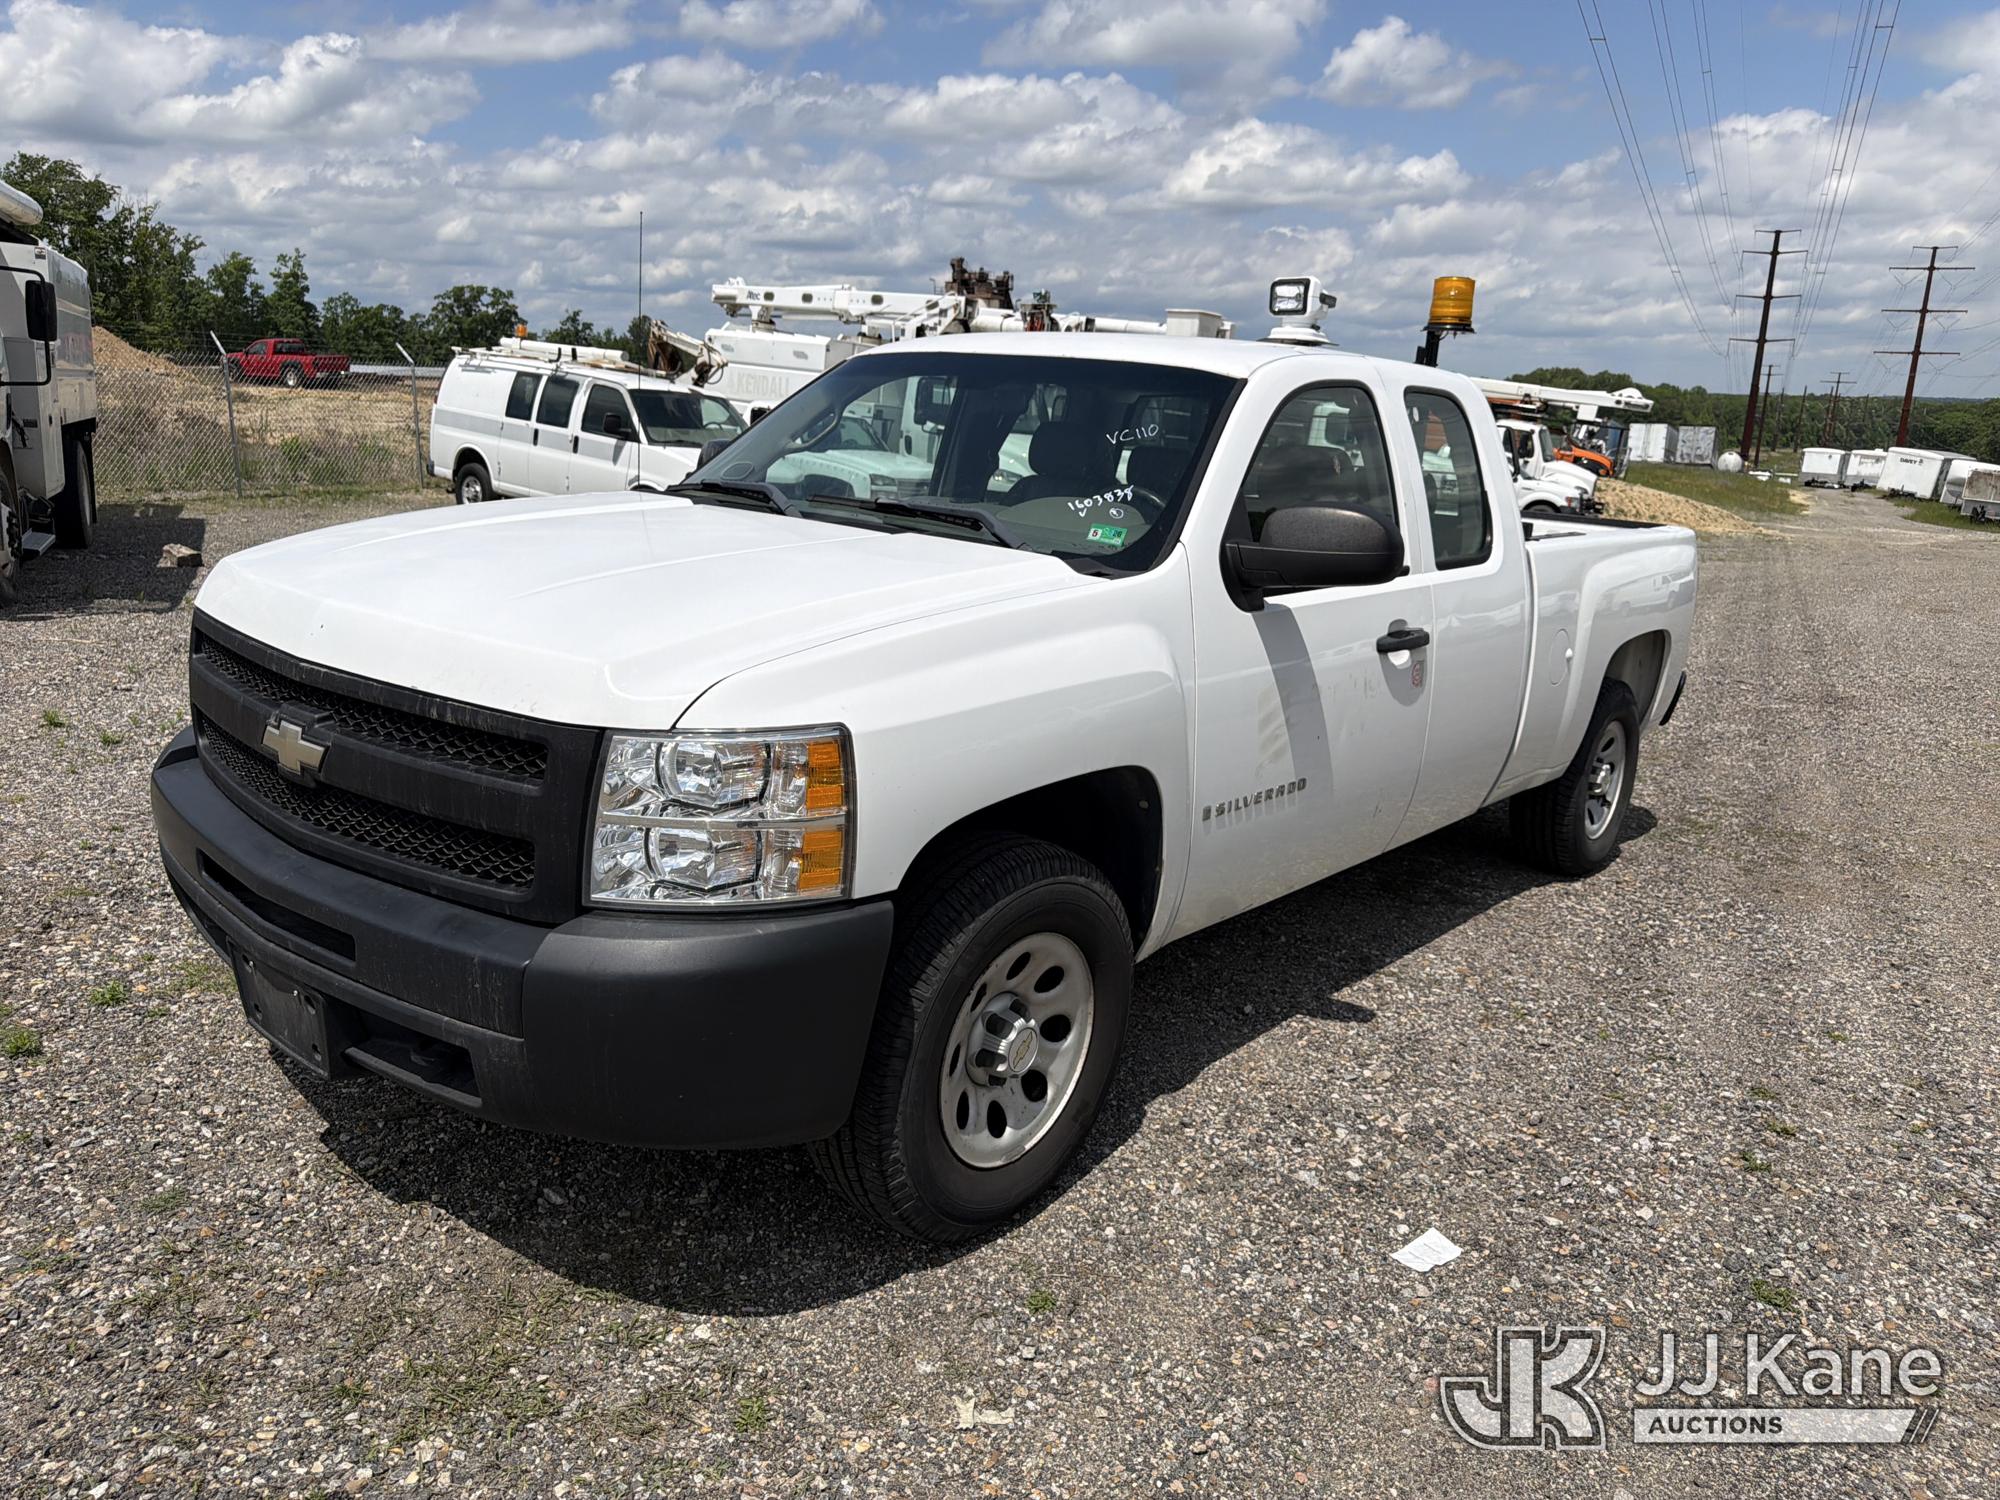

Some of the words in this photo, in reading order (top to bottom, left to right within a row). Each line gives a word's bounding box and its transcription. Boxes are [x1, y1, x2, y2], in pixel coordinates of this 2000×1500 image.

[737, 372, 789, 397] KENDALL
[1106, 424, 1159, 444] VC110
[1067, 484, 1134, 511] 1603838
[1214, 777, 1307, 818] SILVERADO
